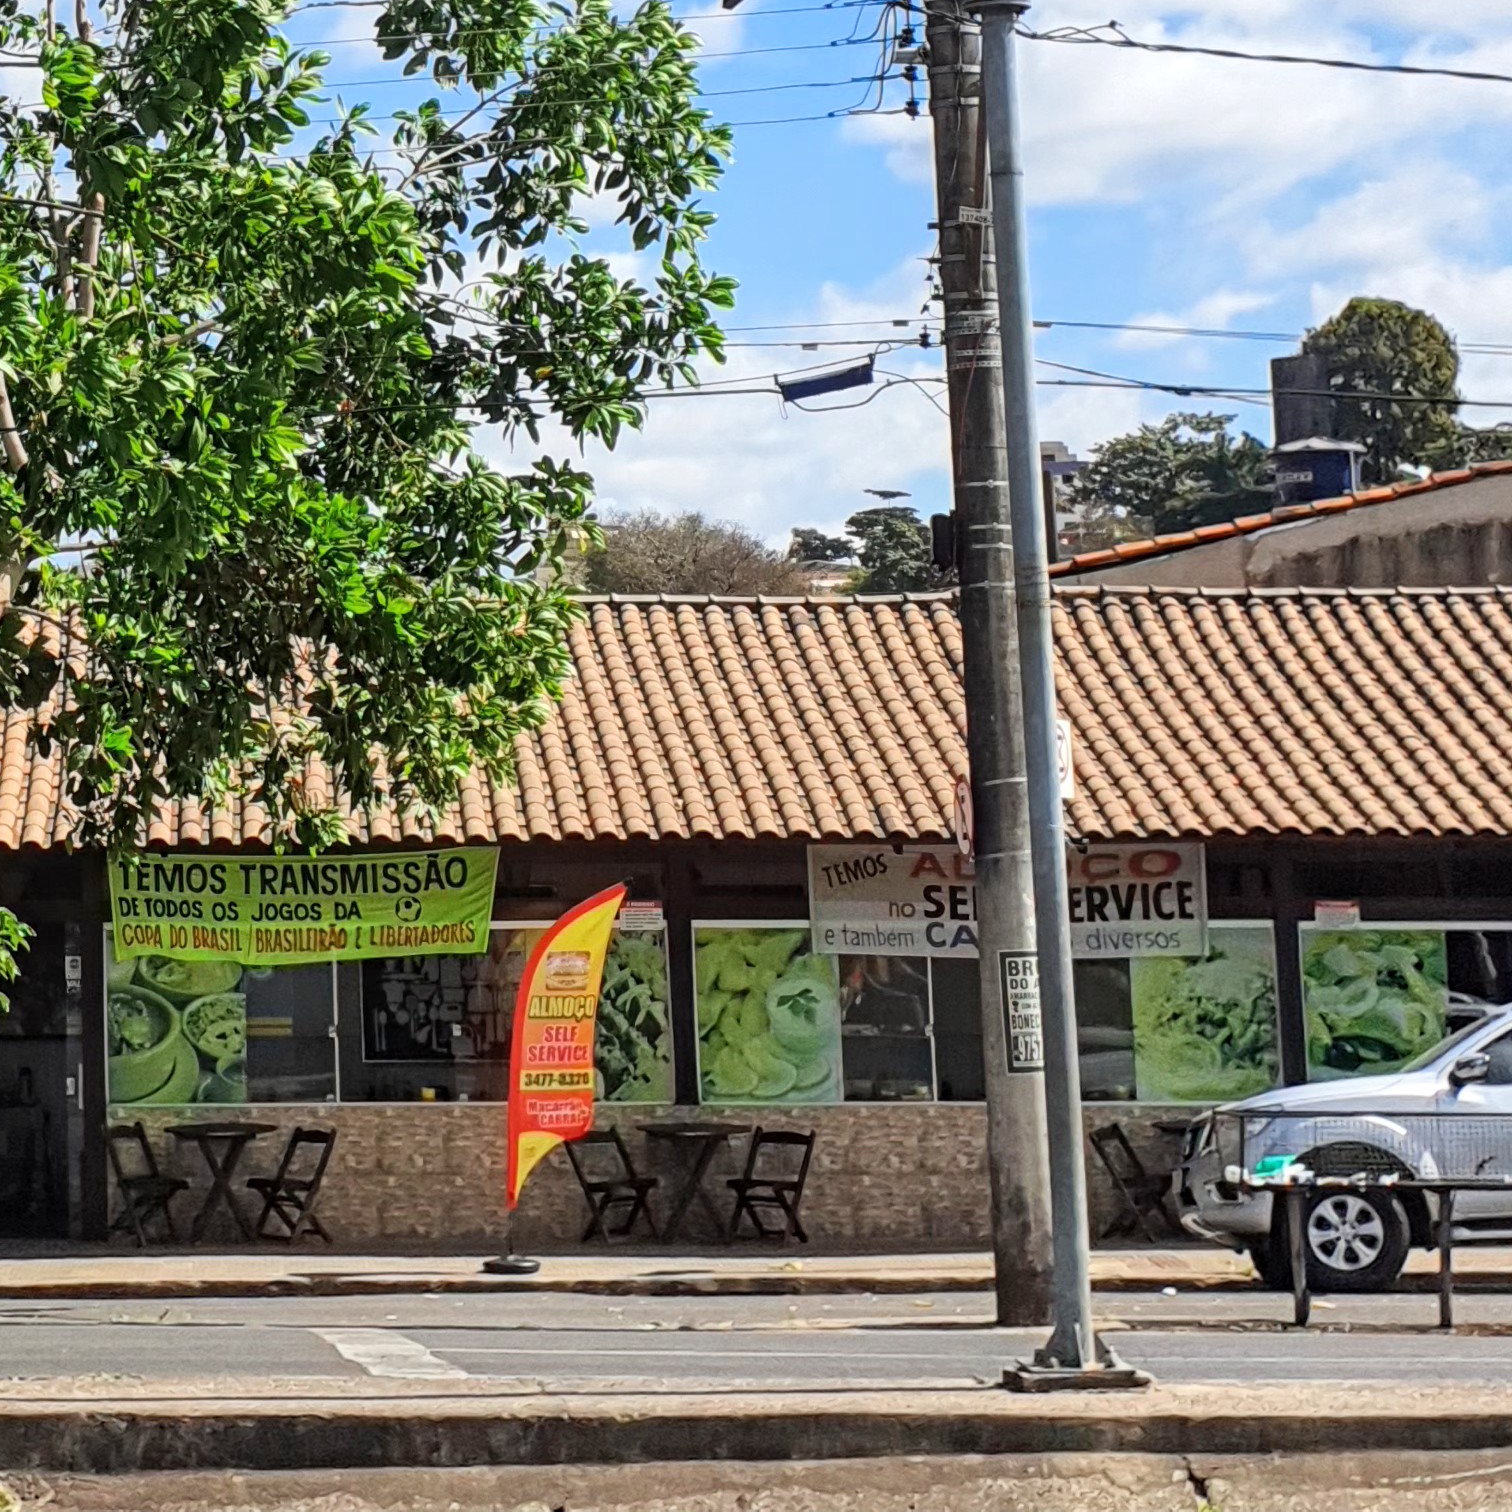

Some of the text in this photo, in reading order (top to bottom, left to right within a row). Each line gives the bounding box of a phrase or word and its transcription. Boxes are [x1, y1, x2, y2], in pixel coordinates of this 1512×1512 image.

[118, 853, 469, 896] TEMOS TRANSMISSÃO
[822, 851, 1182, 889] TEMOS ALÇO
[118, 896, 362, 922] DE TODOS OS JOGOS DA
[889, 901, 916, 918] no
[1068, 882, 1194, 923] ERVICE
[122, 924, 163, 949] COPA
[169, 924, 187, 949] DO
[192, 924, 243, 952] BRASIL
[370, 920, 476, 947] LIBERTADORES
[824, 929, 835, 945] e
[1086, 927, 1181, 950] diversos
[528, 995, 596, 1022] ALMOÇO
[1011, 1014, 1041, 1029] BONEC
[544, 1025, 579, 1042] SELF
[528, 1044, 589, 1063] SERVICE
